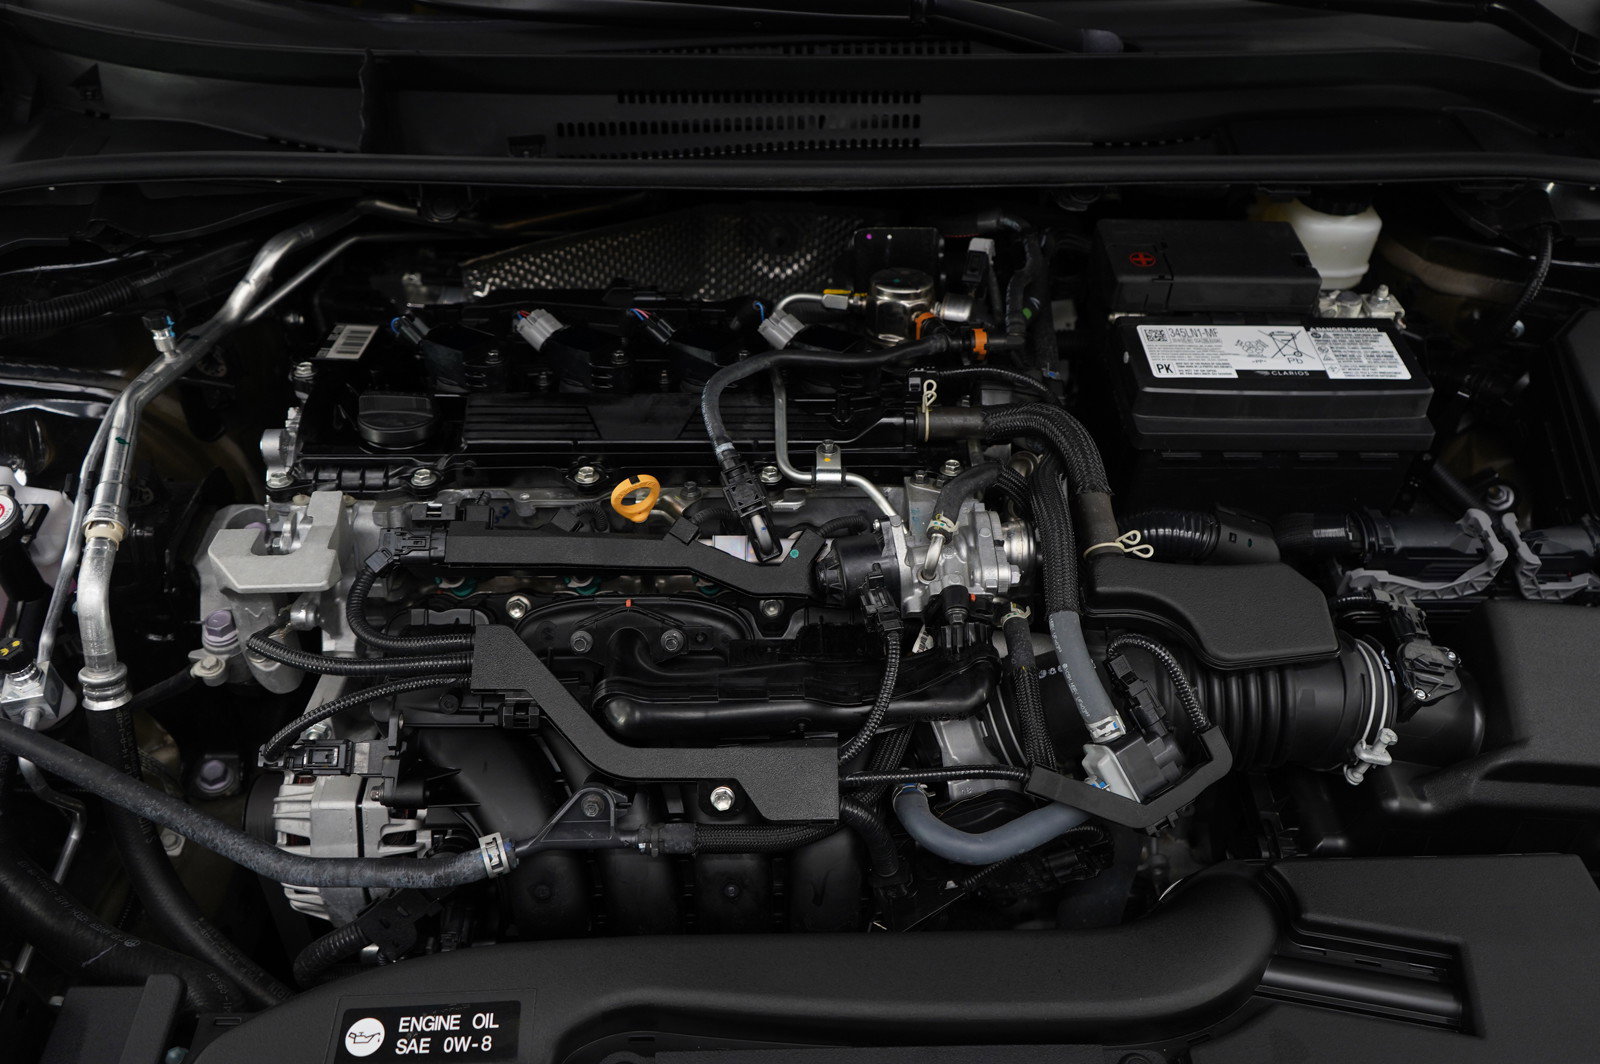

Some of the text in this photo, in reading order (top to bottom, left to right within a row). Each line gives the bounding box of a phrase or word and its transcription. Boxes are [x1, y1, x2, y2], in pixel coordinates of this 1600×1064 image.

[1168, 328, 1219, 338] 345LN1-MF
[1287, 357, 1304, 365] Pb
[1156, 363, 1174, 374] PK
[398, 1012, 500, 1033] ENGINE OIL
[395, 1035, 493, 1055] SAE 0W-8
